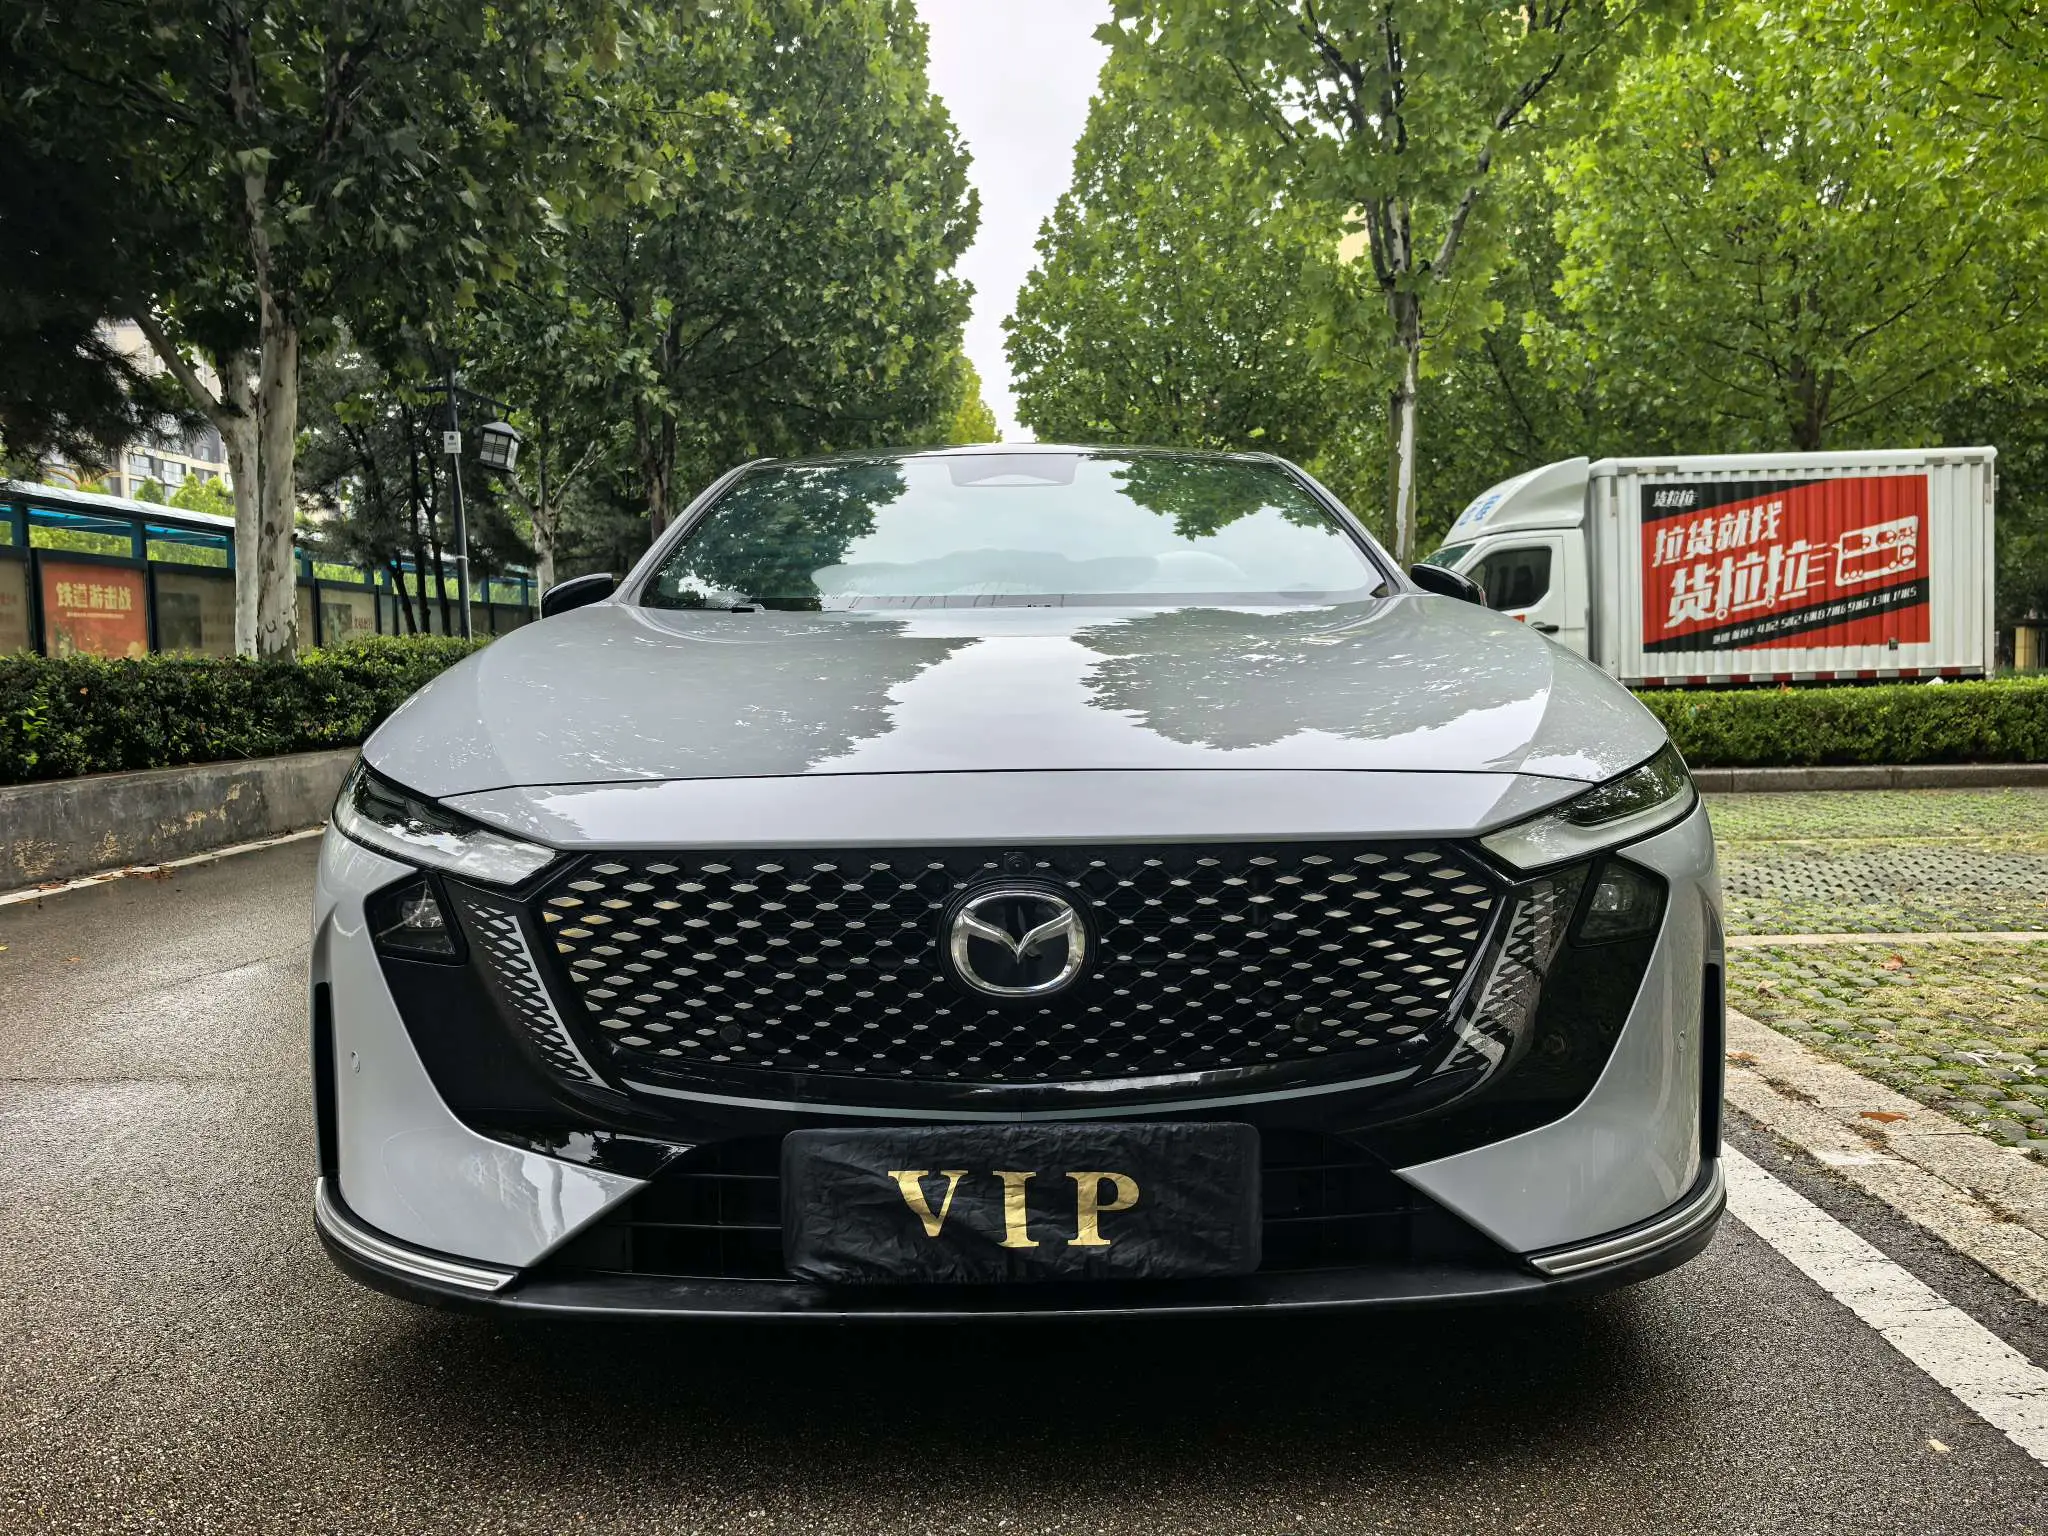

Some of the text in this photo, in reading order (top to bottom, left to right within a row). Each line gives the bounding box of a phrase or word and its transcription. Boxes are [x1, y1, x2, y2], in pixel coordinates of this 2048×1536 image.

[1652, 500, 1783, 568] 拉货就找
[56, 582, 132, 611] 铁道游击战
[1664, 540, 1814, 628] 货拉拉
[1803, 609, 1825, 624] 68
[1847, 597, 1871, 613] 96
[888, 1169, 1141, 1249] VIP
